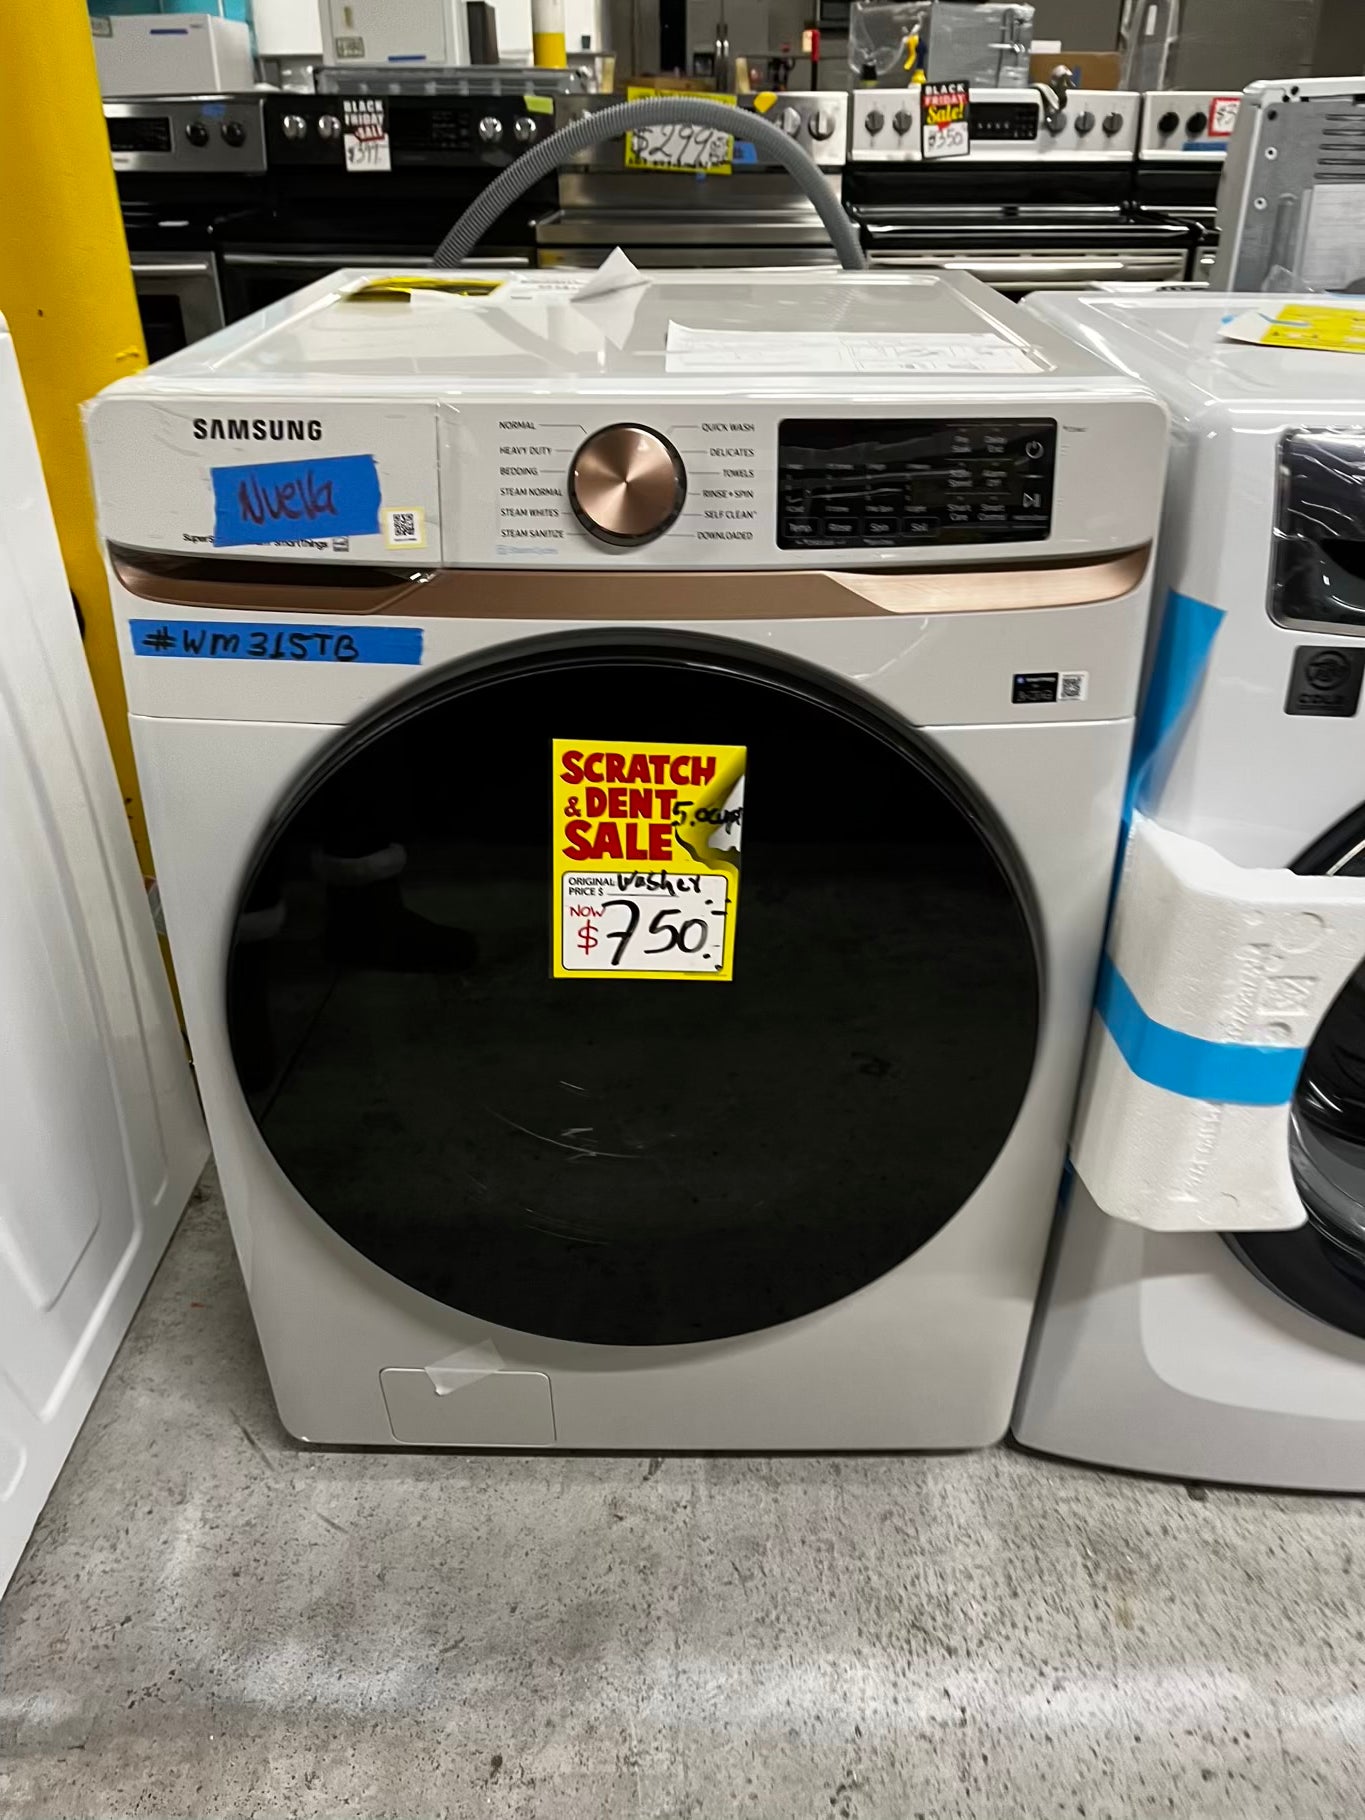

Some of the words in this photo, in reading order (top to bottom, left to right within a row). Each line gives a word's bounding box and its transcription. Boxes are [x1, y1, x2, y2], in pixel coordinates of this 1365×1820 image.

[924, 83, 966, 95] BLACK
[924, 93, 968, 106] FRIDAY
[343, 100, 383, 112] BLACK
[345, 111, 384, 126] FRIDAY
[927, 103, 964, 124] Sale!
[193, 418, 323, 441] SAMSUNG
[499, 421, 536, 430] NORMAL
[702, 423, 728, 432] QUICK
[730, 423, 755, 432] WASH
[499, 446, 527, 455] HEAVY
[529, 446, 552, 455] DUTY
[710, 447, 754, 457] DELICATES
[500, 466, 538, 475] BEDDING
[723, 469, 754, 478] TOWELS
[500, 487, 527, 496] STEAM
[529, 487, 563, 497] NORMAL
[702, 489, 727, 498] RINSE
[734, 489, 754, 498] SPIN
[500, 508, 527, 517] STEAM
[529, 508, 559, 517] WHITES
[704, 510, 724, 519] SELF
[501, 529, 527, 538] STEAM
[529, 529, 564, 538] SANITIZE
[697, 531, 753, 540] DOWNLOADED
[560, 750, 716, 786] SCRATCH
[564, 796, 582, 818] &
[585, 786, 678, 820] DENT
[562, 820, 673, 861] SALE
[568, 877, 615, 887] ORIGINAL
[568, 887, 597, 896] PRICE
[570, 905, 605, 918] NOW
